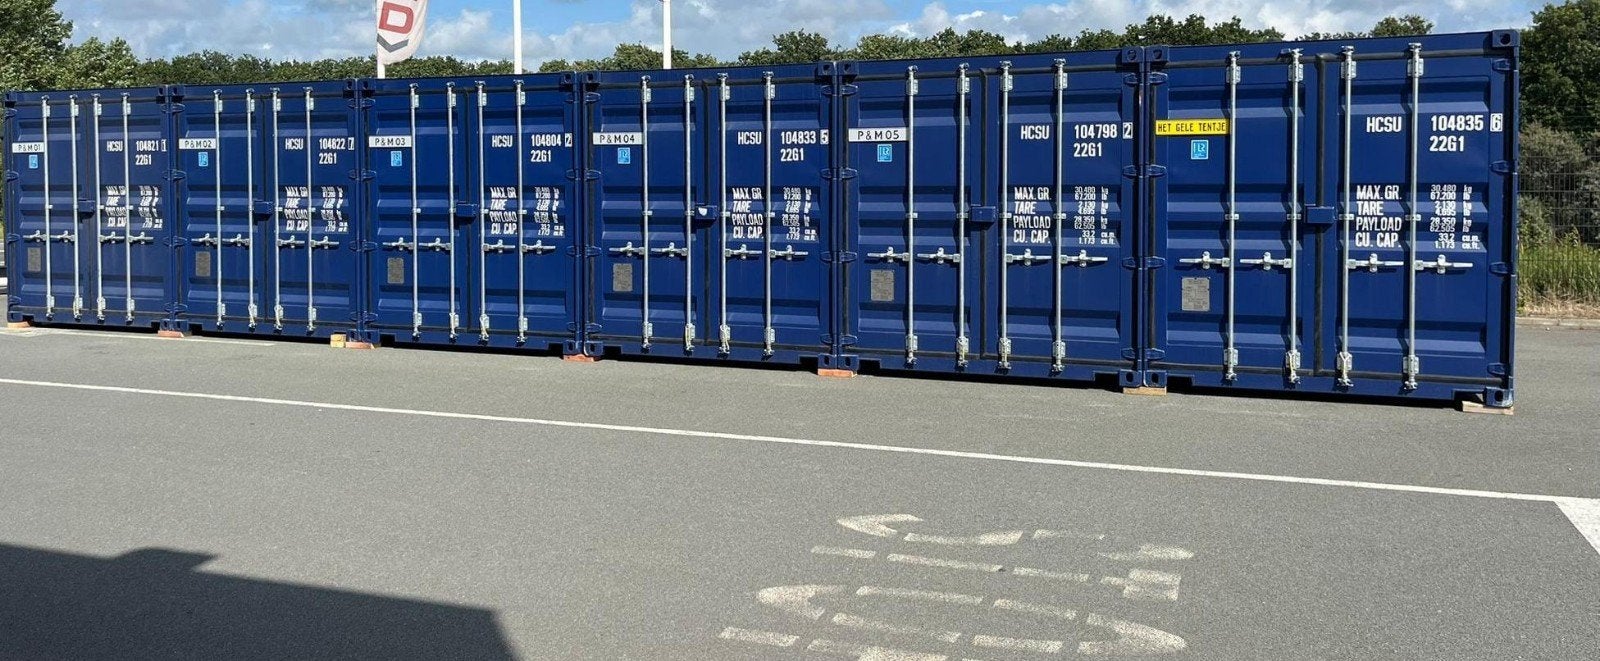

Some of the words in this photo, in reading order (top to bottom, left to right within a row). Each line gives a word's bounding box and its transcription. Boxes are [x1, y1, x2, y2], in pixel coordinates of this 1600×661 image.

[1157, 123, 1171, 132] HET
[1175, 123, 1194, 132] GELE
[1198, 122, 1226, 132] TENTJE
[1366, 116, 1402, 133] HCSU
[1430, 114, 1484, 131] 104835
[1490, 113, 1502, 132] 6
[1020, 125, 1050, 140] HCSU
[1074, 124, 1118, 139] 104798
[1123, 122, 1133, 139] 2
[285, 138, 304, 150] HCSU
[319, 138, 346, 150] 104822
[491, 135, 513, 148] HCSU
[531, 134, 562, 147] 104804
[737, 131, 762, 145] HCSU
[780, 131, 817, 145] 104833
[1429, 135, 1465, 152] 22G1
[106, 140, 123, 152] HCSU
[135, 140, 159, 152] 104821
[1073, 142, 1102, 157] 22G1
[135, 154, 152, 166] 22G1
[318, 152, 337, 164] 22G1
[530, 149, 552, 162] 22G1
[780, 147, 804, 162] 22G1
[1430, 184, 1456, 192] 30.480
[1430, 192, 1456, 200] 67.200
[490, 199, 507, 210] TARE
[733, 201, 752, 213] TARE
[1014, 201, 1037, 215] TARE
[1357, 201, 1384, 216] TARE
[1435, 201, 1456, 209] 2.130
[489, 211, 517, 222] PAYLOAD
[732, 213, 764, 226] PAYLOAD
[1013, 215, 1051, 229] PAYLOAD
[1430, 217, 1456, 225] 28.350
[1356, 217, 1402, 231] PAYLOAD
[733, 227, 745, 239] CU.
[747, 227, 764, 239] CAP.
[1013, 229, 1028, 243] CU.
[1031, 229, 1051, 243] CAP.
[1355, 232, 1373, 247] CU.
[1377, 232, 1401, 247] CAP.
[1438, 233, 1455, 241] 33.2
[1435, 241, 1455, 249] 1.173
[719, 513, 1195, 661] STO
